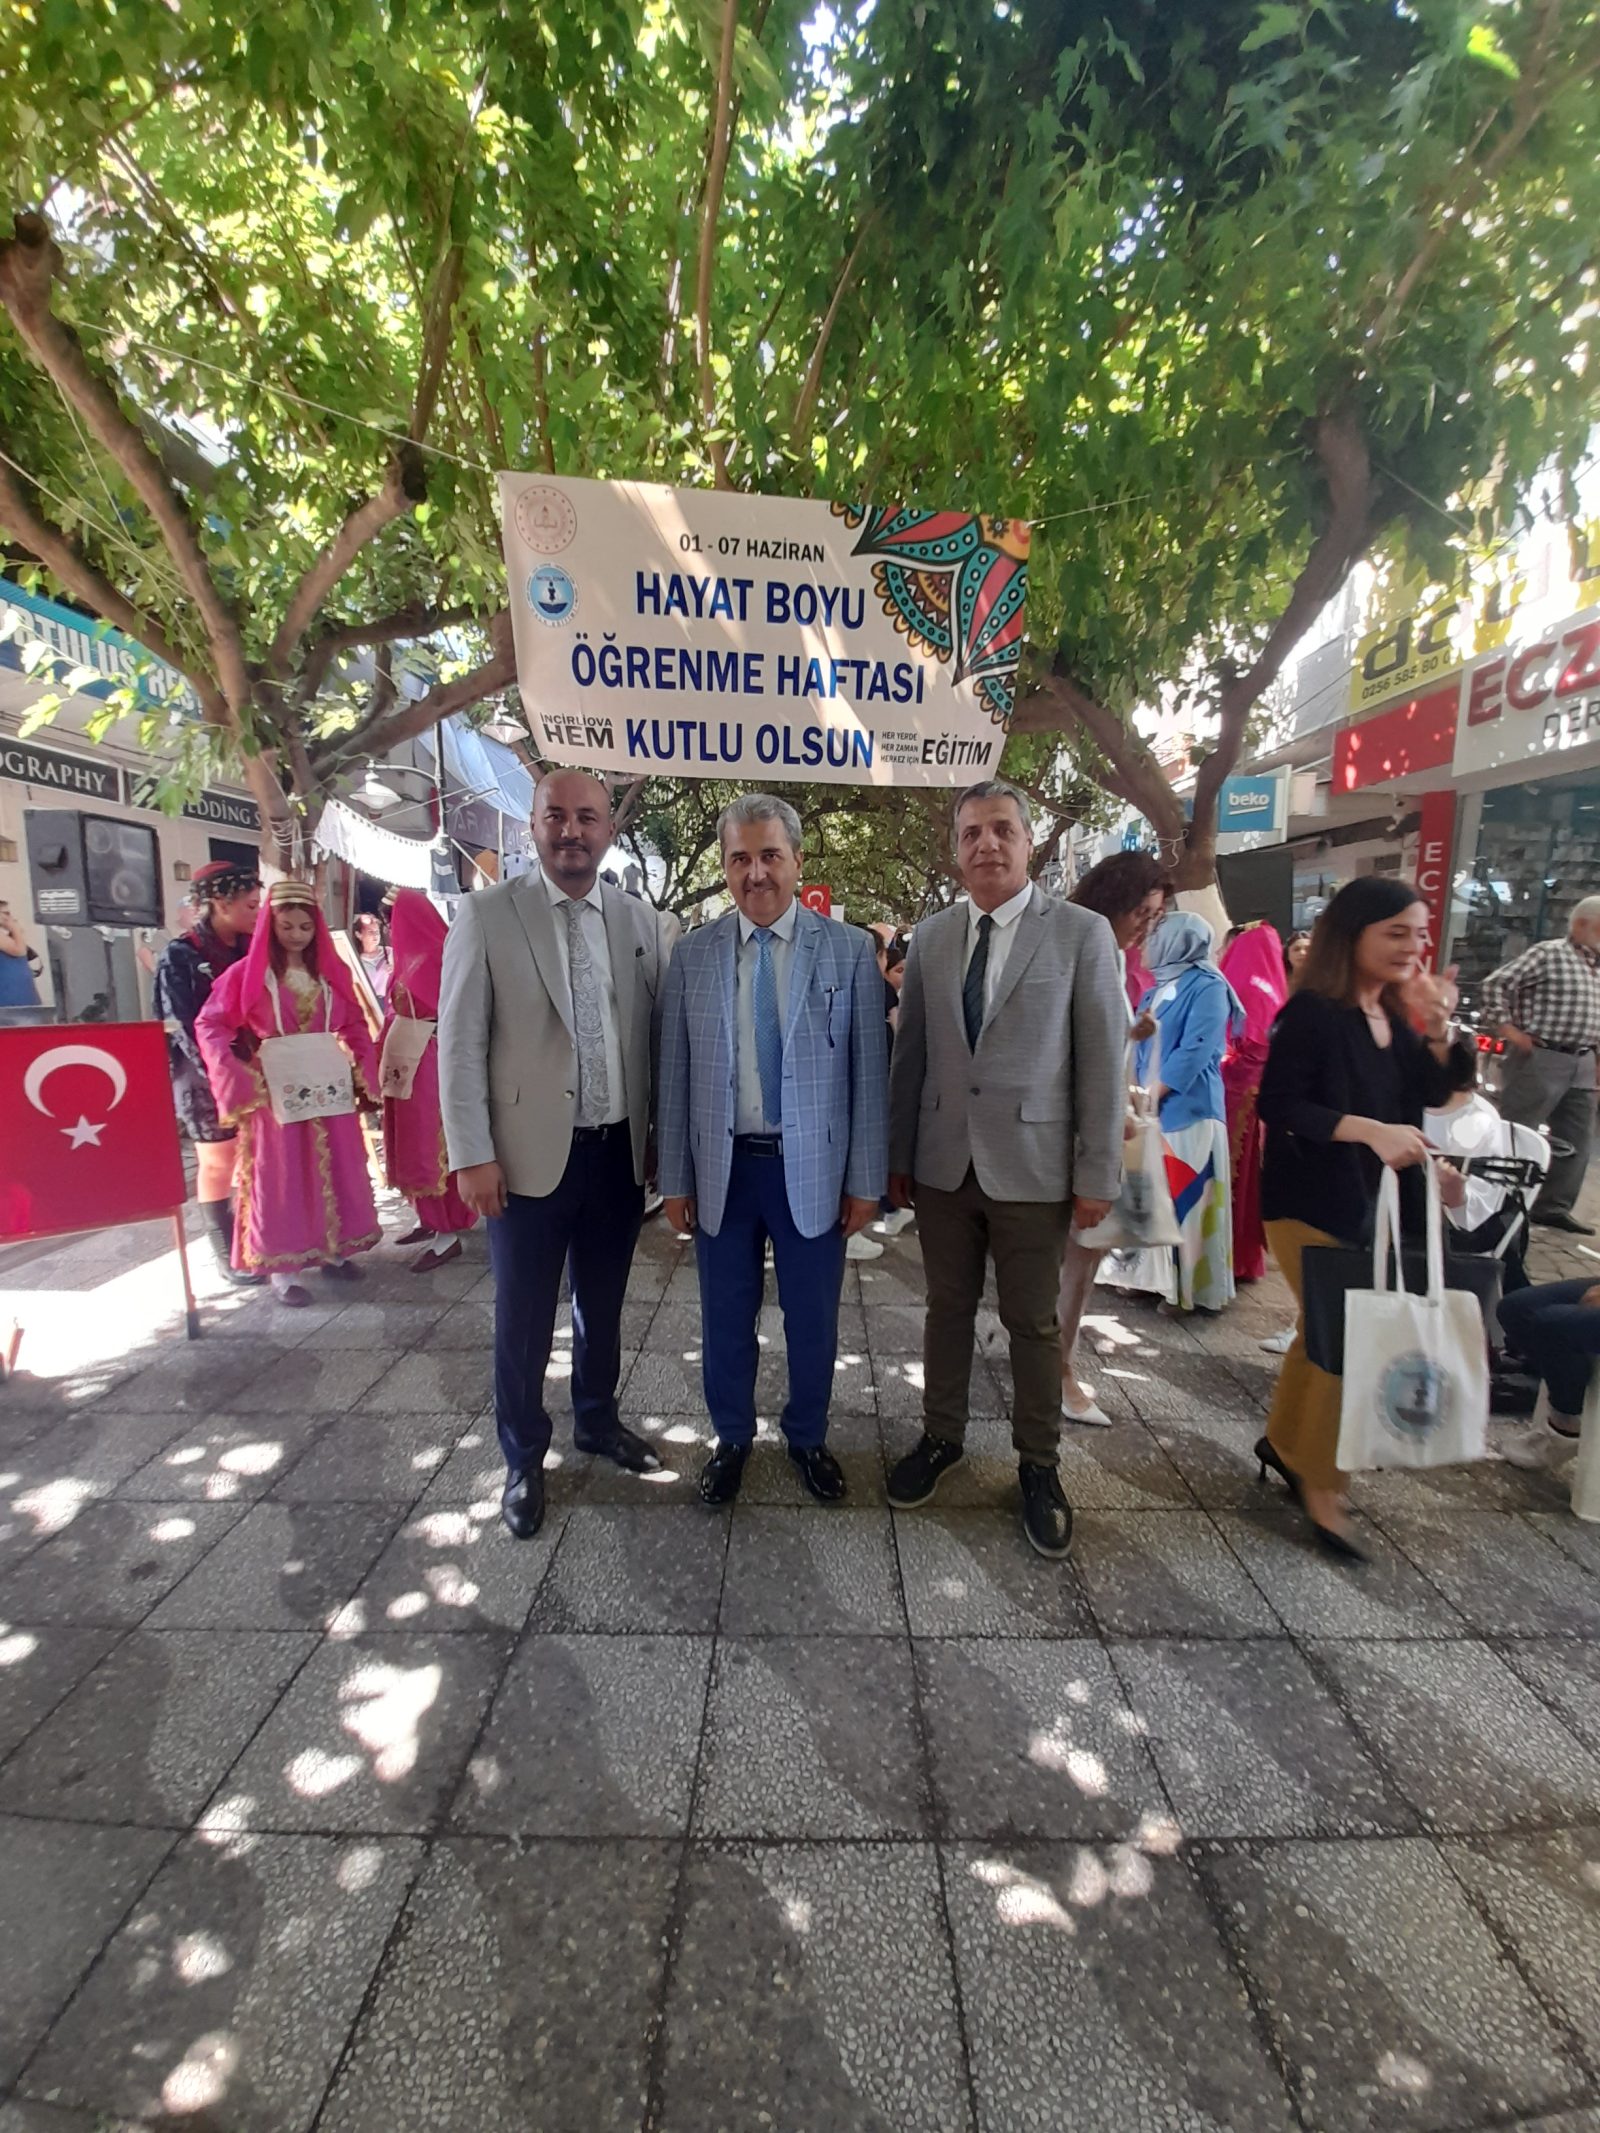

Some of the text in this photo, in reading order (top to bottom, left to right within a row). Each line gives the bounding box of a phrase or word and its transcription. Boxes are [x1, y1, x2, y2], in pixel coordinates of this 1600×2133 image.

[679, 533, 703, 553] 01
[718, 536, 740, 556] 07
[746, 537, 825, 563] HAZİRAN
[636, 570, 754, 622] HAYAT
[766, 580, 865, 630] BOYU
[571, 632, 925, 705] ÖĞRENME HAFTASI
[540, 711, 613, 728] İNCİRLİOVA
[542, 723, 614, 750] HEM
[626, 718, 874, 769] KUTLU OLSUN
[881, 743, 919, 753] HER ZAMAN
[882, 731, 918, 742] HER YERDE
[921, 732, 993, 766] EĞİTİM
[1229, 791, 1270, 807] beko
